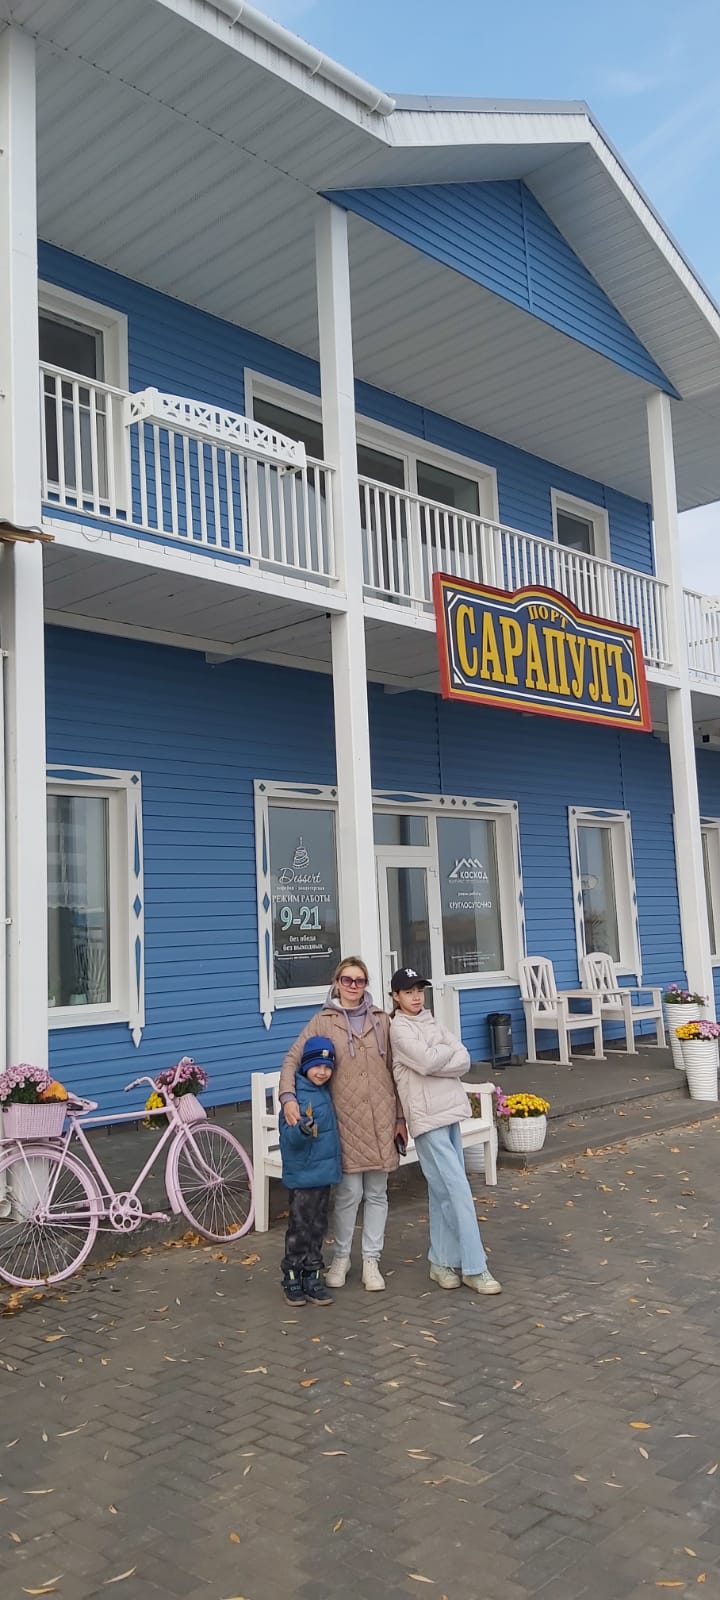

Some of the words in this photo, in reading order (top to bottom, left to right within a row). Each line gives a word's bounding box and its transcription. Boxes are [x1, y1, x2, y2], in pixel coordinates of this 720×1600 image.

[527, 605, 568, 629] ПОРТ
[456, 604, 635, 707] САРАПУЛЪ
[279, 867, 321, 884] Dessert
[449, 901, 491, 909] КРУГЛОСУТОЧНО
[280, 906, 321, 931] 9-21
[300, 934, 316, 942] обеда
